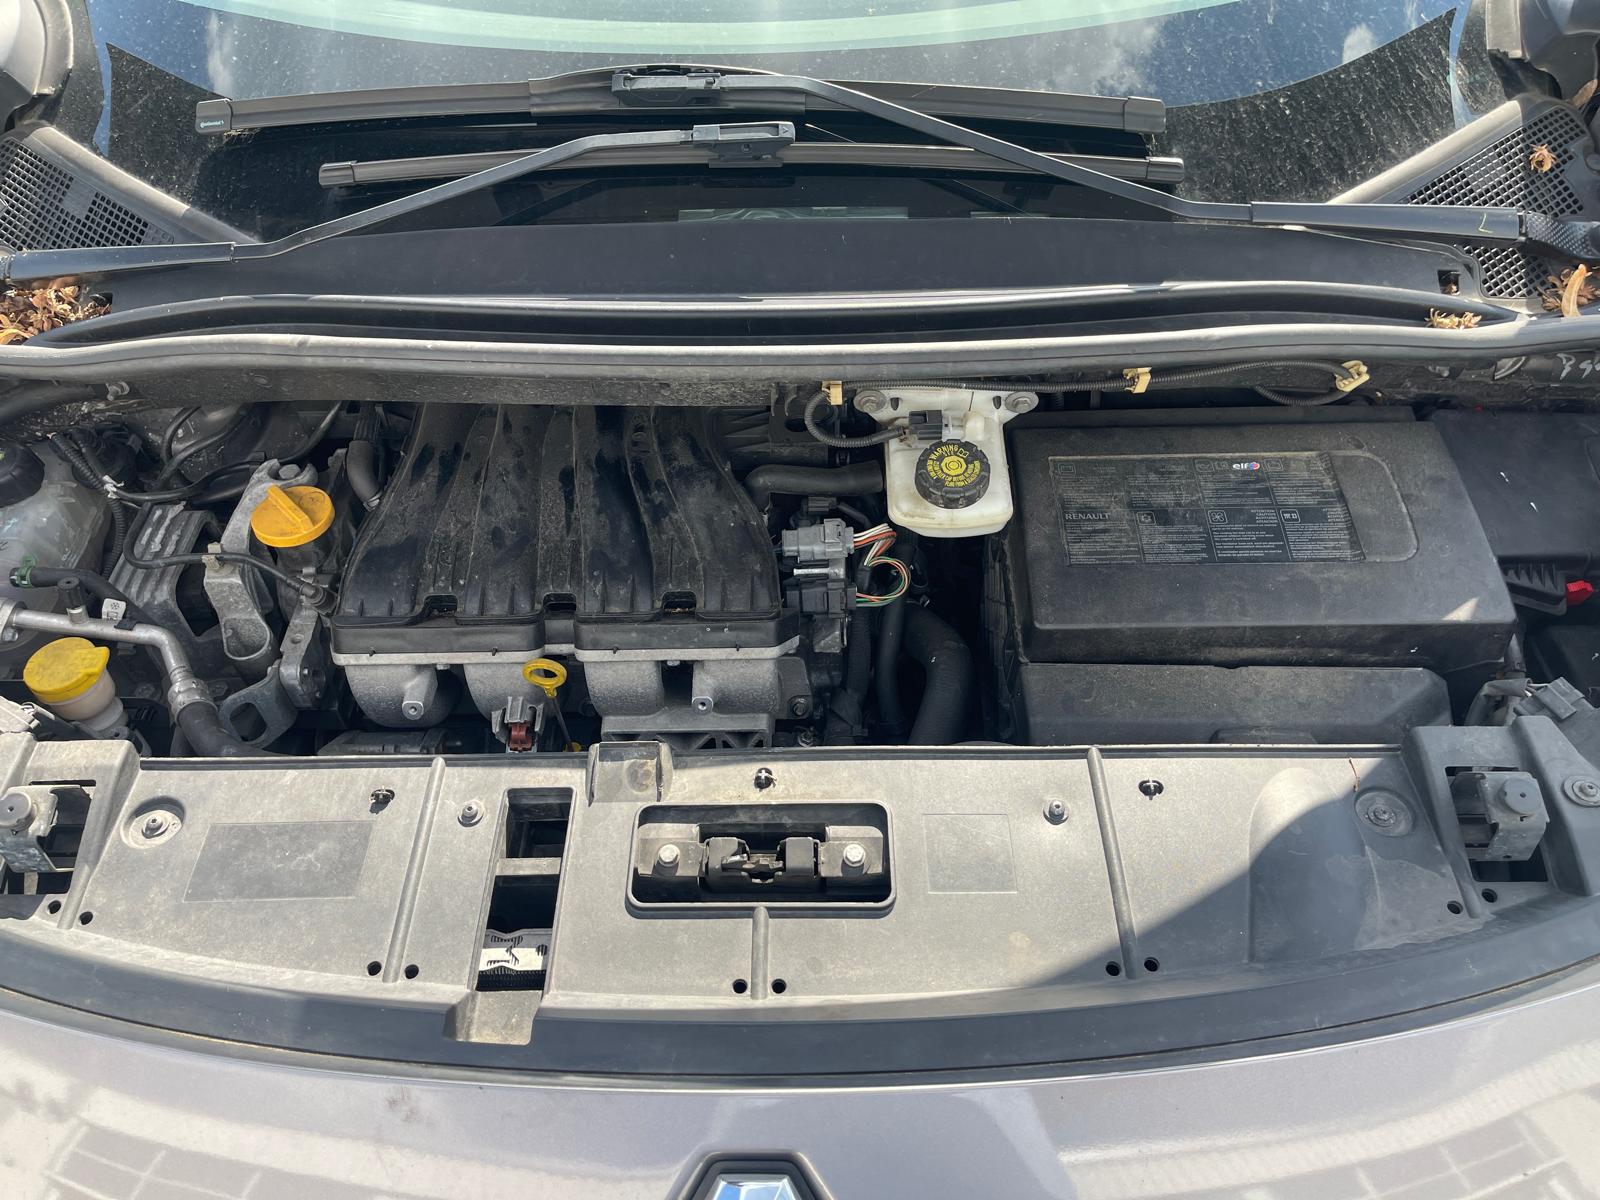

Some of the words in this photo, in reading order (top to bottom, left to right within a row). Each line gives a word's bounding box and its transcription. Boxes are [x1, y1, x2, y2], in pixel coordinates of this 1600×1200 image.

[929, 445, 958, 459] WARNING
[1232, 462, 1249, 470] elf
[1065, 512, 1110, 521] RENAULT
